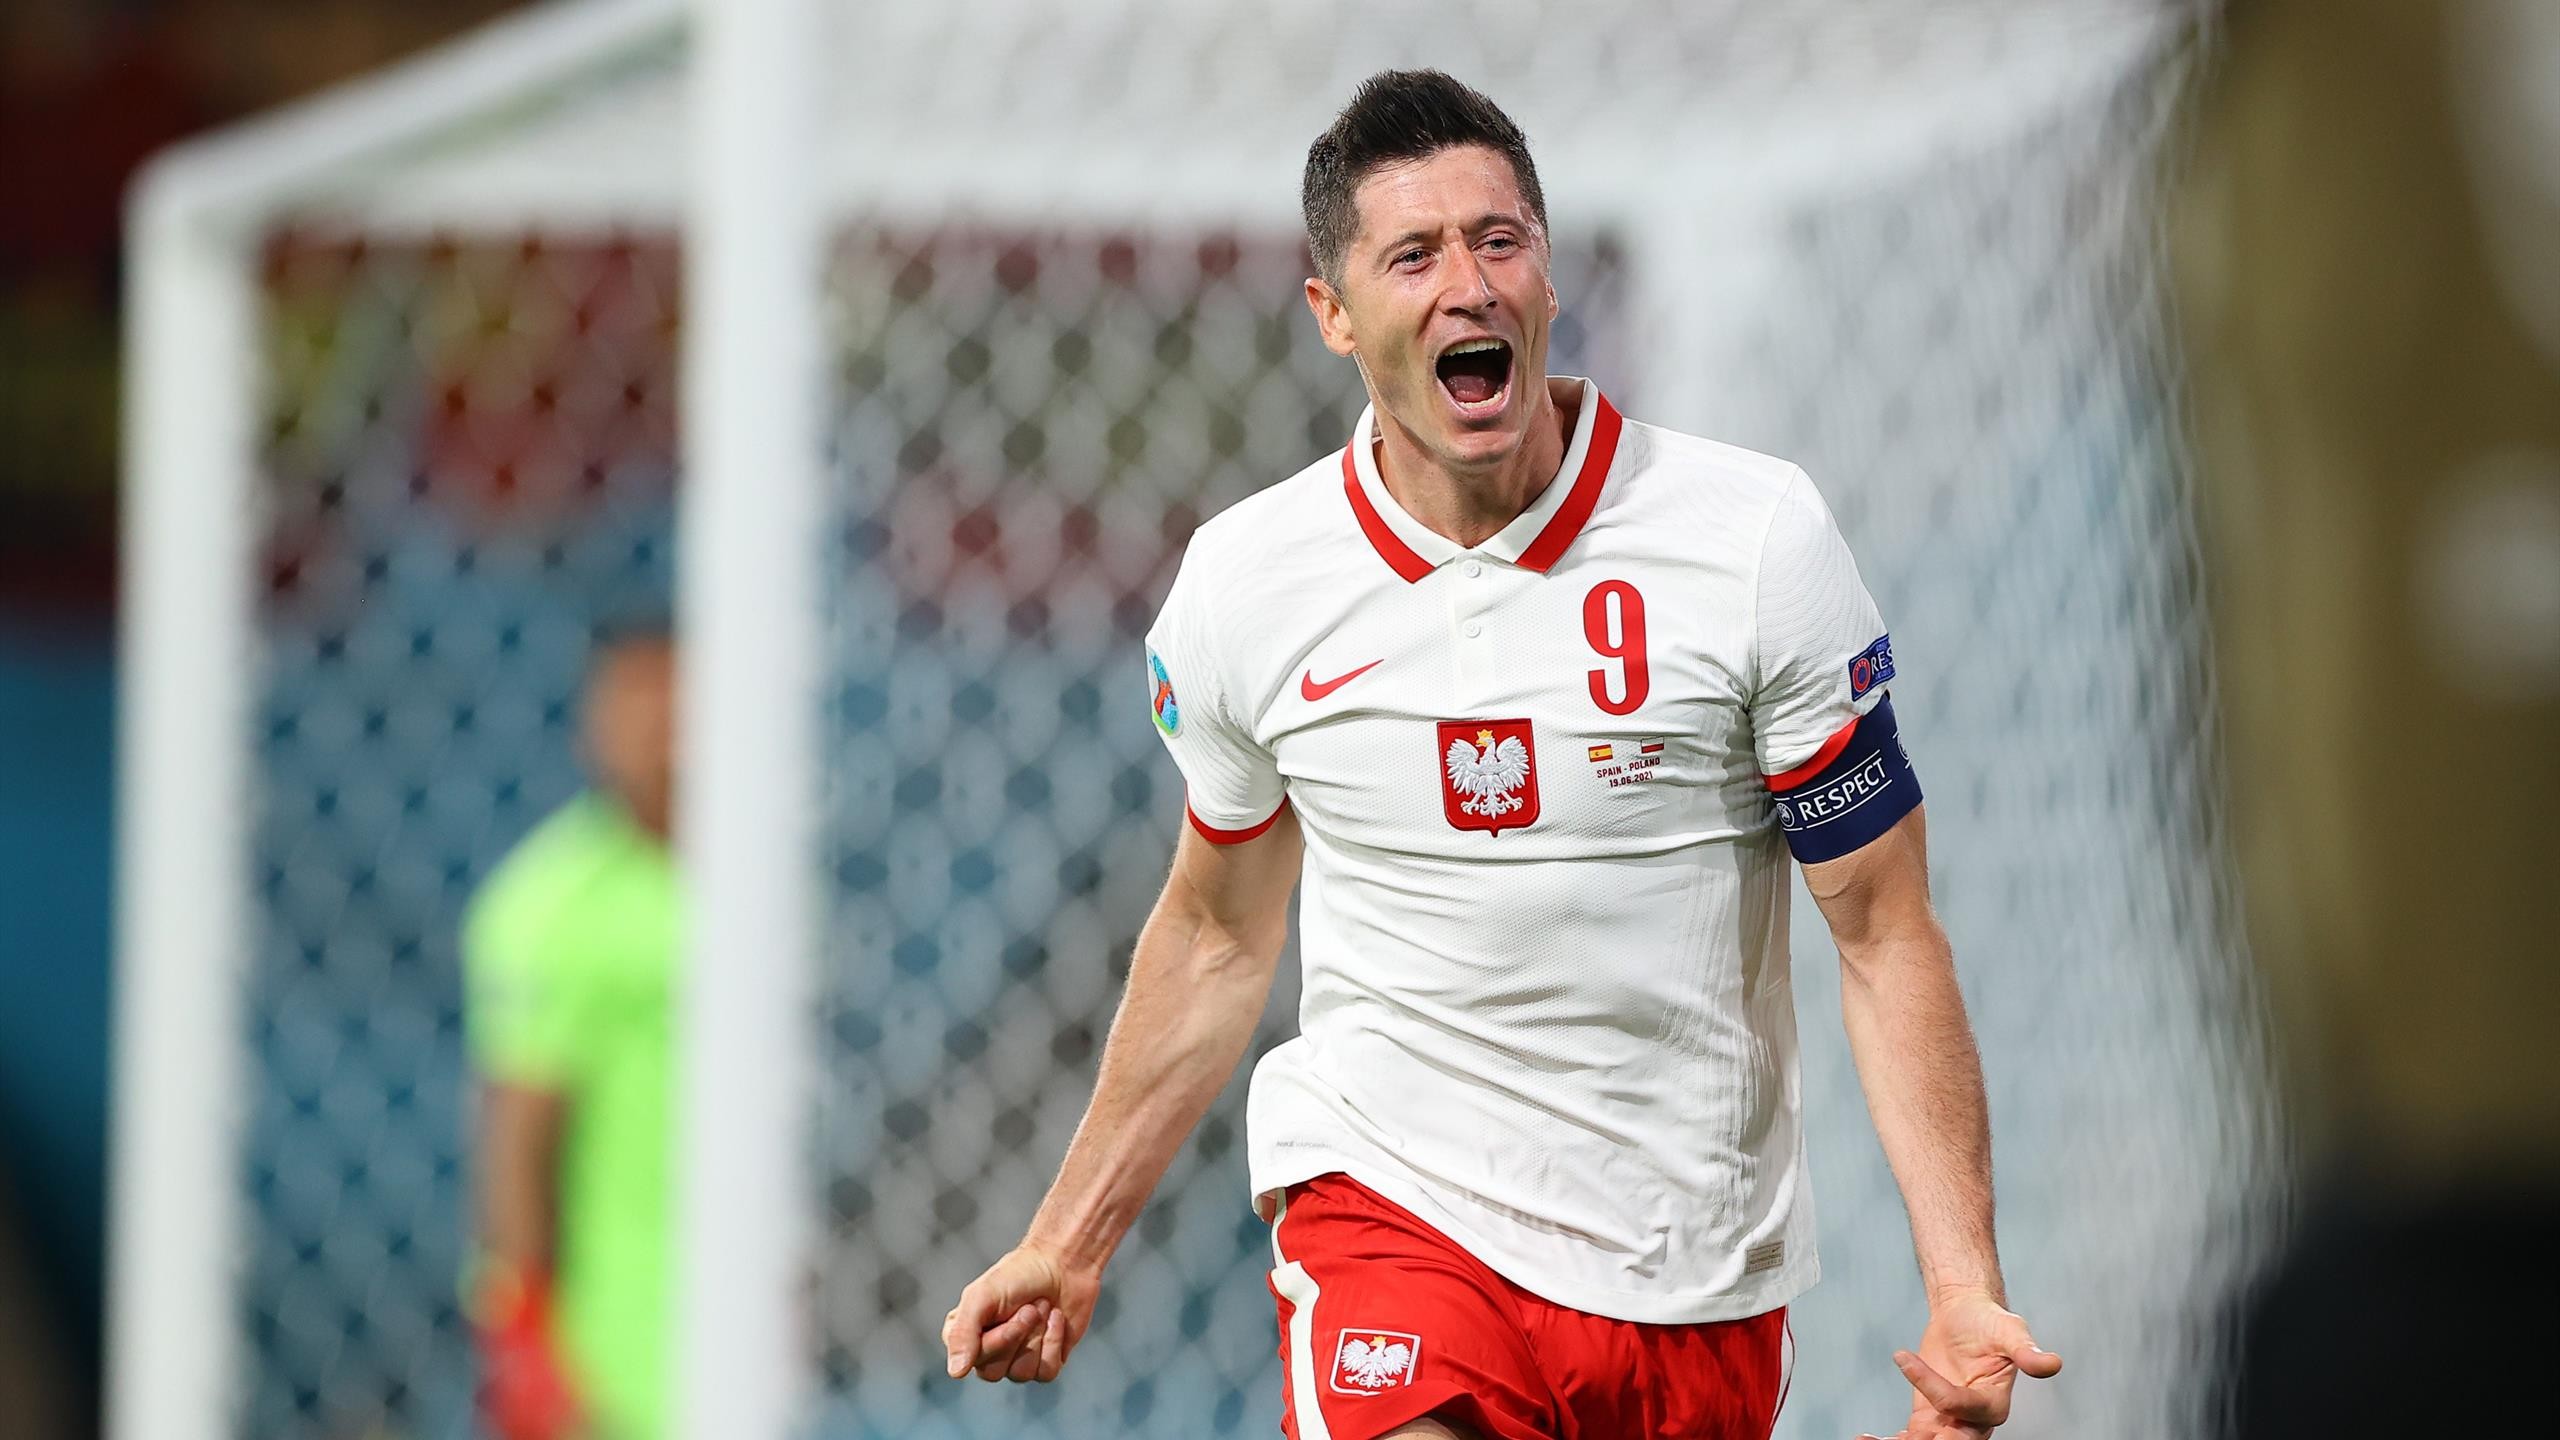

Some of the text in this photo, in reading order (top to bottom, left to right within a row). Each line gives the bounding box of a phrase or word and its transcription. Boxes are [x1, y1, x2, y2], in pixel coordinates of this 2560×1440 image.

[1583, 579, 1649, 716] 9
[1597, 766, 1622, 779] SPAIN
[1629, 757, 1661, 771] POLAND
[1609, 771, 1653, 788] 19.06.2021
[1799, 757, 1887, 821] RESPECT
